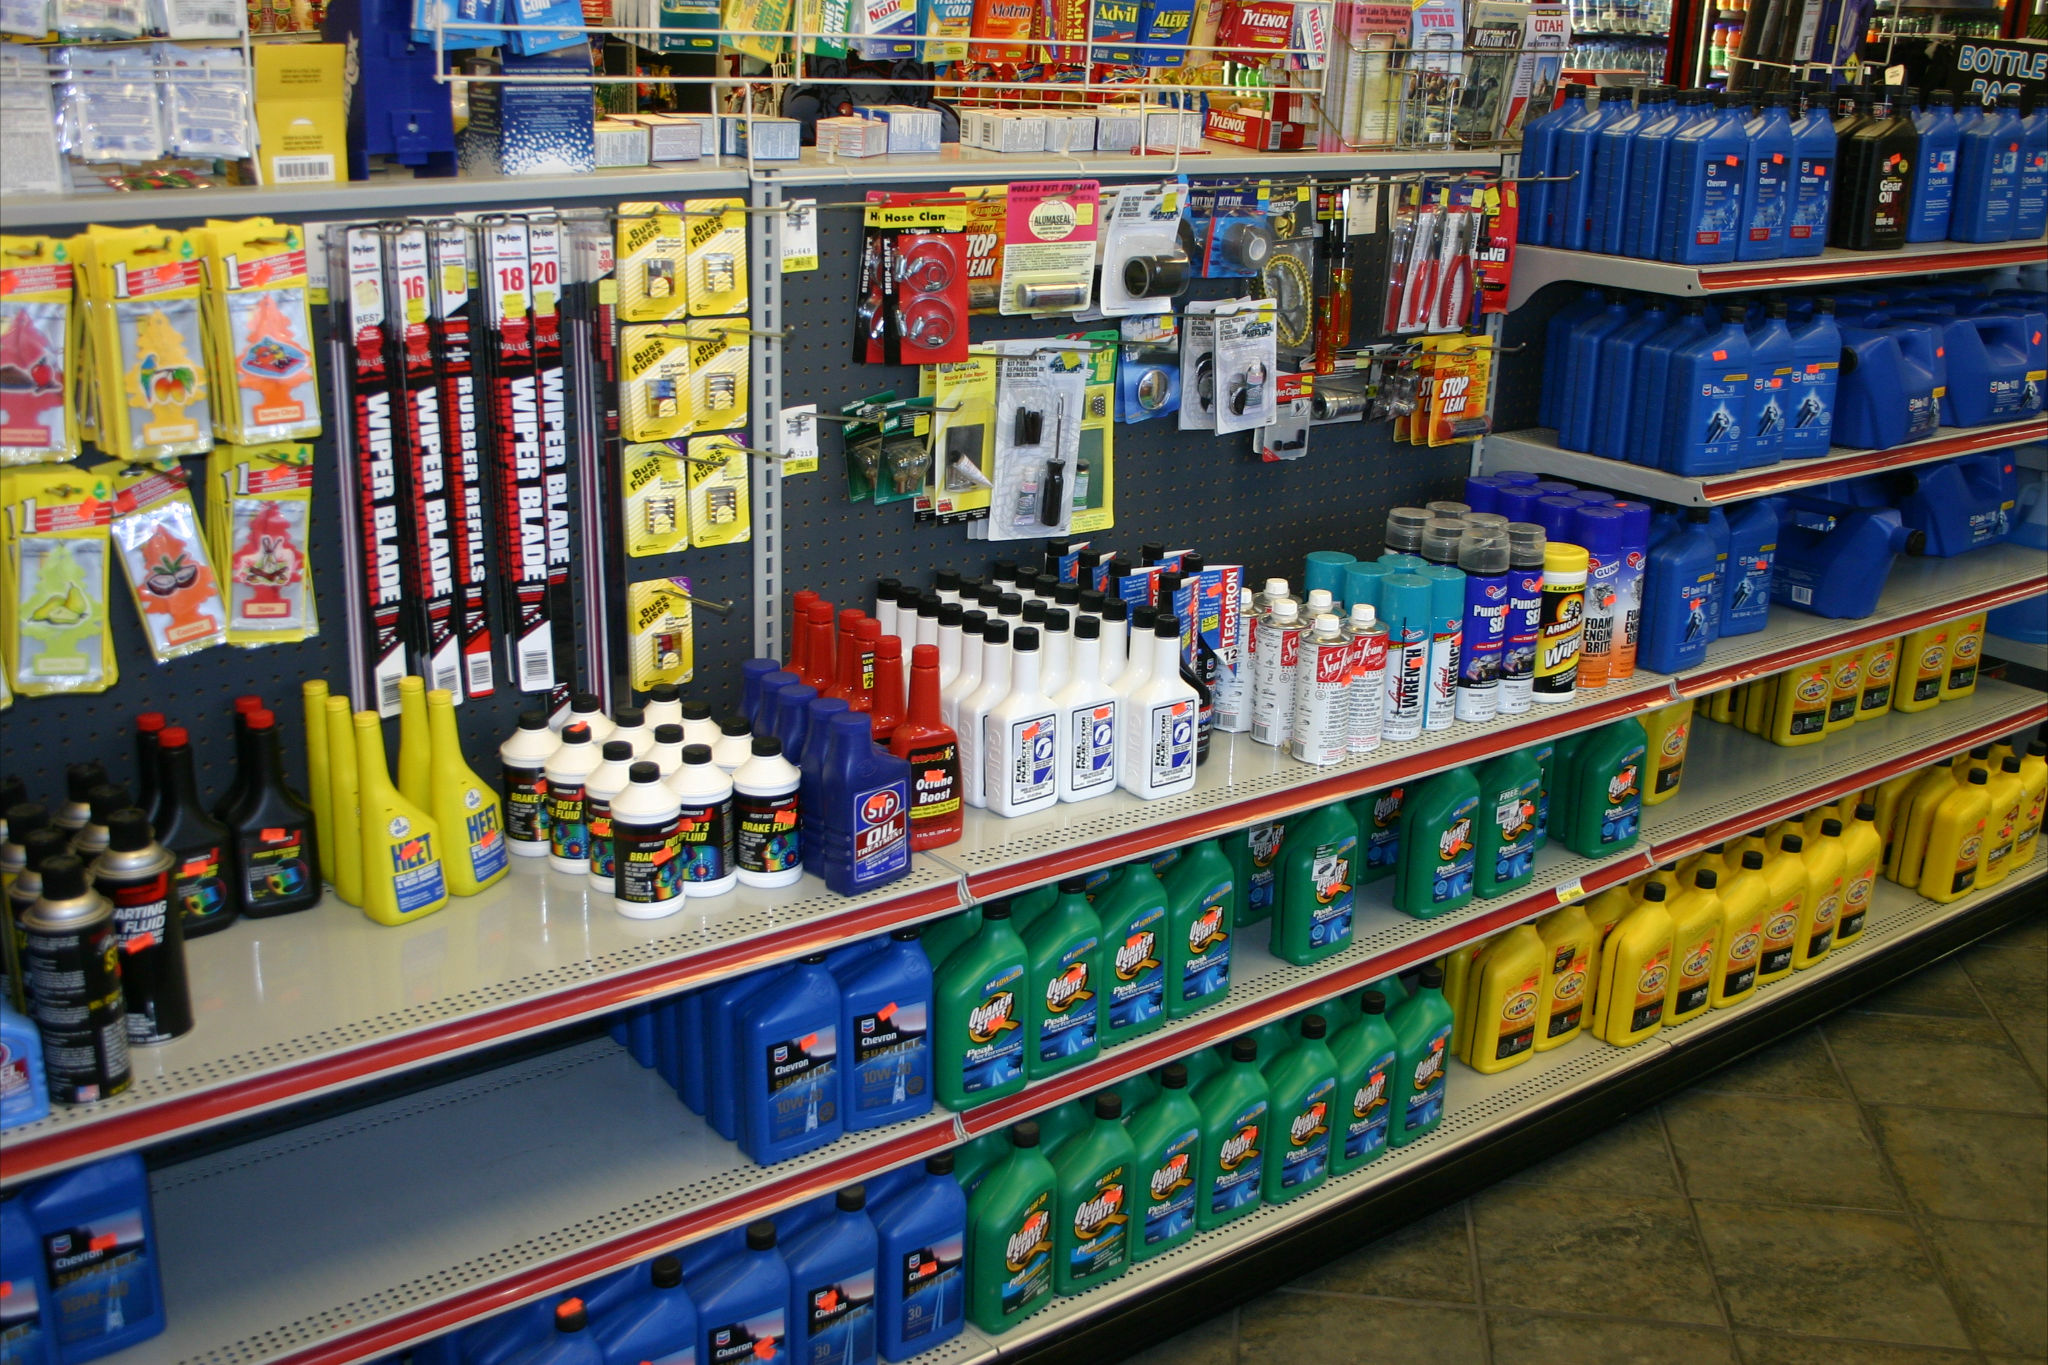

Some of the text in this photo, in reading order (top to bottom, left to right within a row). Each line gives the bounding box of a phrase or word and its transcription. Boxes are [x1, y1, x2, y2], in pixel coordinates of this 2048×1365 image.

[945, 4, 971, 17] COLD
[989, 3, 1031, 18] Motrin
[1096, 4, 1138, 23] Advil
[1241, 9, 1290, 29] TYLENOL
[1153, 12, 1191, 28] ALEVE
[1421, 14, 1455, 27] UTAH
[1535, 19, 1564, 33] UTAH
[1958, 45, 2048, 80] BOTTLE
[1209, 112, 1246, 133] TYLENOL
[1880, 180, 1903, 192] Gear
[1878, 191, 1893, 204] Oil
[693, 215, 723, 235] Buss
[885, 213, 914, 223] Hose
[1034, 215, 1071, 226] ALUMASEAL
[532, 229, 554, 238] Pylon
[629, 217, 660, 240] Buss
[691, 222, 724, 248] Fuses
[401, 242, 421, 251] Pylon
[440, 238, 464, 248] Pylon
[497, 234, 521, 244] Pylon
[627, 226, 661, 251] Fuses
[353, 244, 376, 253] Pylon
[499, 267, 525, 292] 18
[531, 261, 558, 285] 20
[403, 276, 426, 299] 16
[356, 313, 381, 324] BEST
[501, 340, 532, 351] VALUE
[633, 340, 664, 363] Buss
[695, 341, 728, 366] Fuses
[357, 355, 386, 367] VALUE
[406, 351, 433, 363] VALUE
[632, 348, 665, 375] Fuses
[1440, 376, 1469, 398] STOP
[1443, 397, 1467, 413] LEAK
[457, 377, 480, 482] RUBBER
[368, 392, 395, 500] WIPER
[417, 387, 444, 500] WIPER
[542, 367, 570, 565] WIPER BLADE
[632, 457, 660, 479] Buss
[511, 376, 547, 582] WIPER BLADE
[465, 486, 486, 582] REFILLS
[375, 505, 402, 604] BLADE
[426, 499, 453, 599] BLADE
[1595, 562, 1619, 578] GUNK
[640, 594, 668, 618] Buss
[1222, 571, 1239, 648] TECHRON
[638, 603, 671, 630] Fuses
[1546, 618, 1575, 636] ARMOR
[1222, 650, 1239, 664] 12
[511, 793, 539, 803] BRAKE
[920, 788, 951, 804] Boost
[1500, 787, 1520, 801] FREE
[557, 800, 583, 810] DOT 3
[1605, 806, 1622, 816] Peak
[466, 803, 499, 845] HEET
[556, 810, 580, 820] FLUID
[702, 822, 710, 831] 3
[742, 821, 770, 833] BRAKE
[867, 820, 898, 846] OIL
[1440, 818, 1471, 849] QUAKER
[682, 832, 707, 842] FLUID
[857, 827, 904, 858] TREATMENT
[1499, 843, 1517, 853] Peak
[1437, 863, 1456, 875] Peak
[1313, 906, 1333, 918] Peak
[124, 916, 165, 934] FLUID
[1194, 922, 1217, 946] STATE
[1121, 947, 1149, 972] STATE
[1187, 955, 1207, 968] Peak
[1052, 977, 1081, 1004] STATE
[1113, 982, 1137, 995] Peak
[1118, 978, 1161, 998] Performance
[969, 992, 1013, 1028] QUAKER
[1044, 1014, 1069, 1027] Peak
[1048, 1010, 1093, 1030] Performance
[861, 1032, 897, 1047] Chevron
[862, 1040, 921, 1060] SUPREME
[967, 1044, 994, 1058] Peak
[972, 1041, 1020, 1061] Performance
[775, 1058, 809, 1076] Chevron
[1418, 1061, 1439, 1085] STATE
[1358, 1087, 1381, 1112] STATE
[1410, 1091, 1428, 1103] Peak
[1297, 1116, 1323, 1139] STATE
[1349, 1119, 1369, 1131] Peak
[1226, 1138, 1251, 1162] STATE
[1286, 1147, 1309, 1160] Peak
[1157, 1167, 1183, 1193] STATE
[1216, 1171, 1239, 1184] Peak
[1081, 1201, 1115, 1231] STATE
[1148, 1201, 1171, 1215] Peak
[1012, 1230, 1042, 1263] STATE
[54, 1248, 104, 1269] Chevron
[907, 1305, 923, 1320] 30
[716, 1340, 753, 1359] Chevron
[815, 1343, 831, 1358] 30
